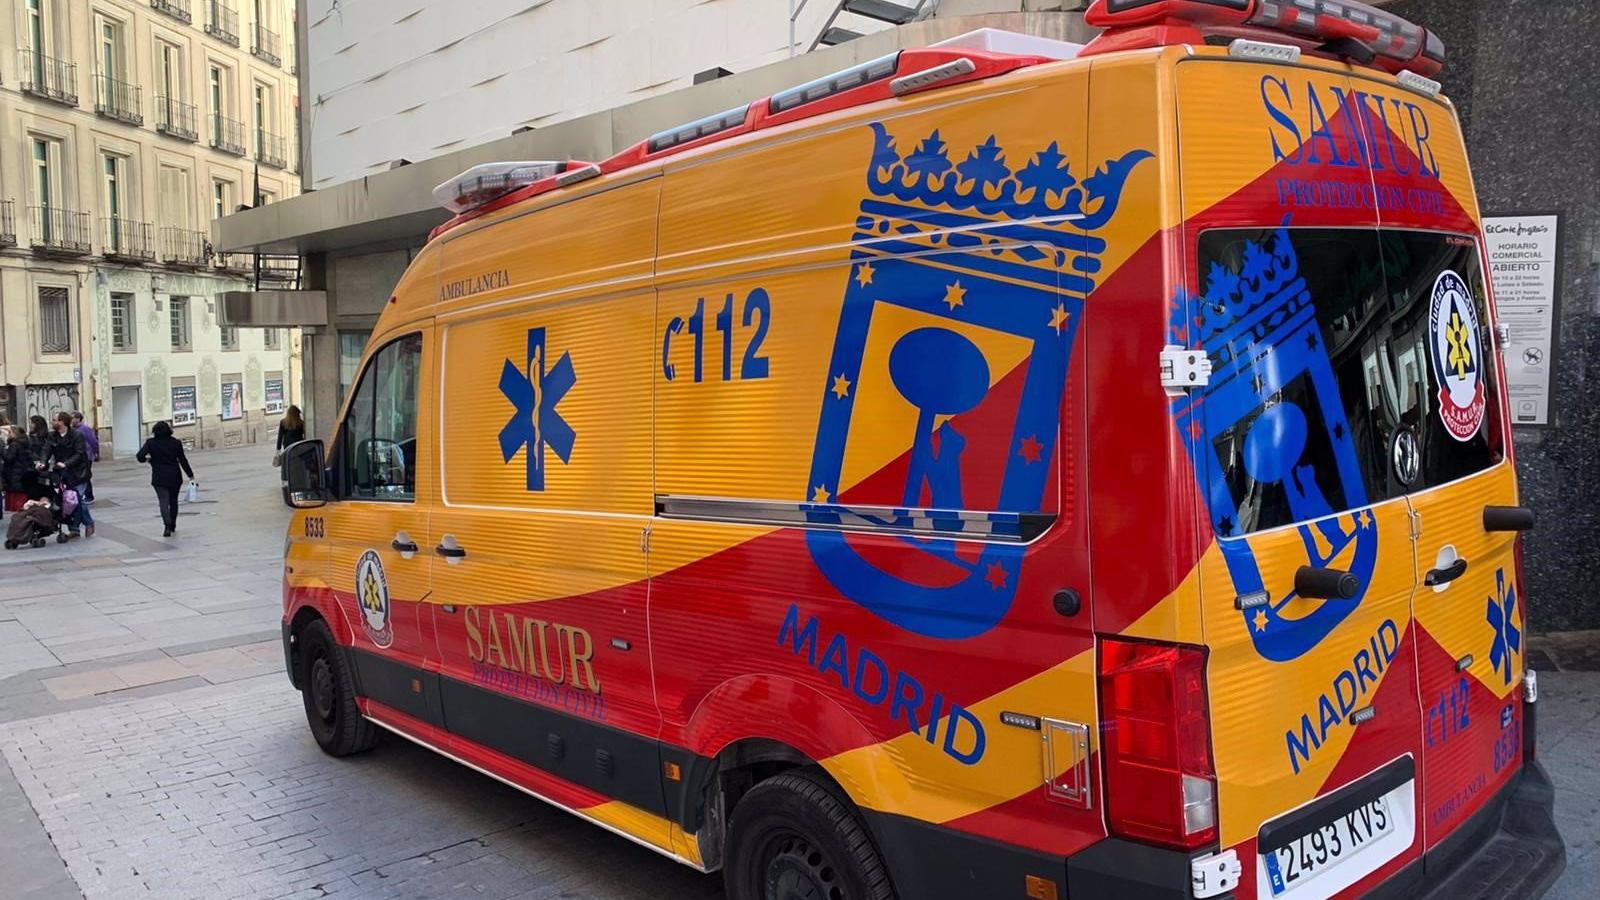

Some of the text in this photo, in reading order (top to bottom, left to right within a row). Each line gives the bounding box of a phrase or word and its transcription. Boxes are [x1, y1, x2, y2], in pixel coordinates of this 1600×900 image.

[1260, 74, 1440, 181] SAMUR
[1407, 189, 1446, 217] CIVIL
[1492, 251, 1542, 259] COMERCIAL
[1493, 263, 1540, 271] ABIERTO
[440, 268, 509, 302] AMBULANCIA
[1432, 281, 1446, 333] ciudad
[1445, 275, 1454, 289] de
[688, 287, 771, 383] 112
[304, 516, 325, 539] 8533
[464, 605, 602, 694] SAMUR
[776, 603, 987, 766] MADRID
[1285, 619, 1400, 776] MADRID
[1439, 678, 1471, 742] 112
[1433, 774, 1487, 826] AMBULANCIA
[1280, 799, 1386, 883] 2493 KVS
[1273, 874, 1280, 886] E
